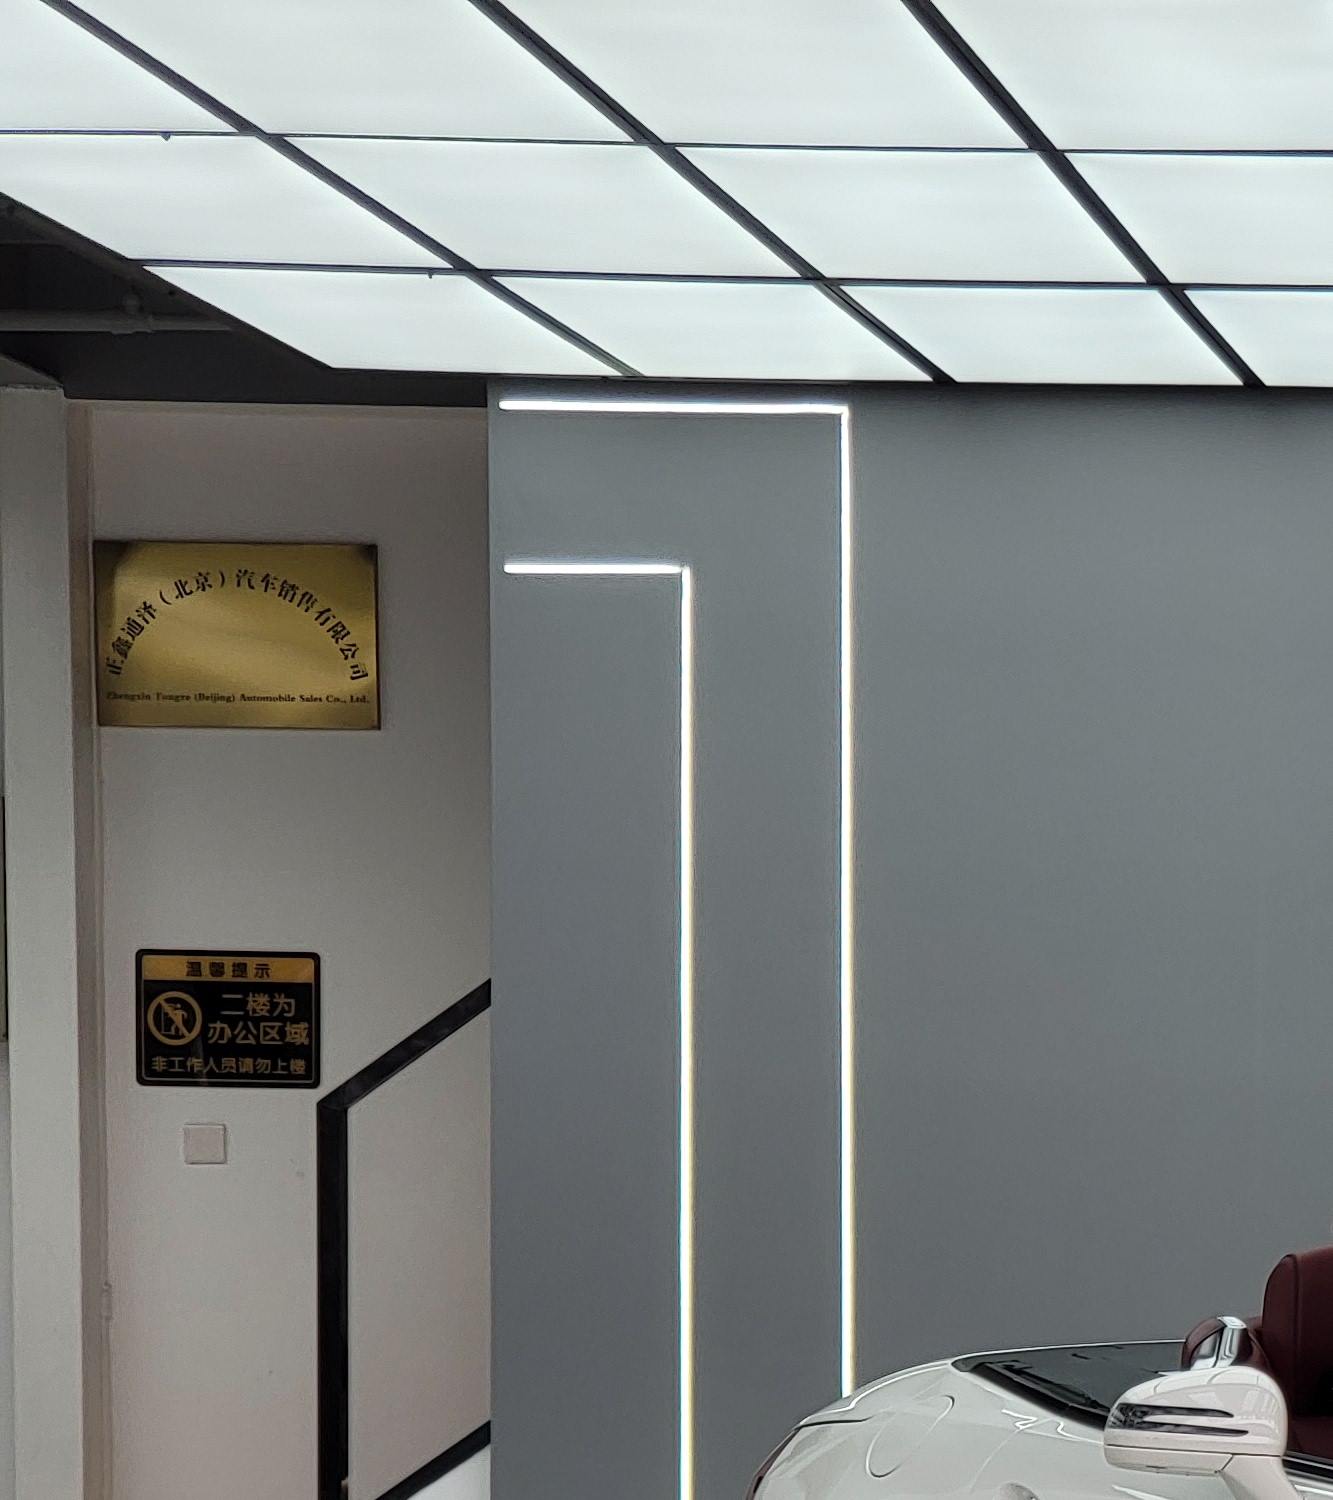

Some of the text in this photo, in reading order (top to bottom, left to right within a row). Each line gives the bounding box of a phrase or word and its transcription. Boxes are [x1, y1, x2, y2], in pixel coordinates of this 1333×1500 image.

[240, 692, 296, 702] Automobile
[299, 694, 322, 703] Sales
[186, 961, 271, 978] 温馨提示
[221, 992, 296, 1017] 二楼为
[207, 1021, 309, 1045] 办公区域
[151, 1055, 306, 1075] 非工作人员请勿上楼
